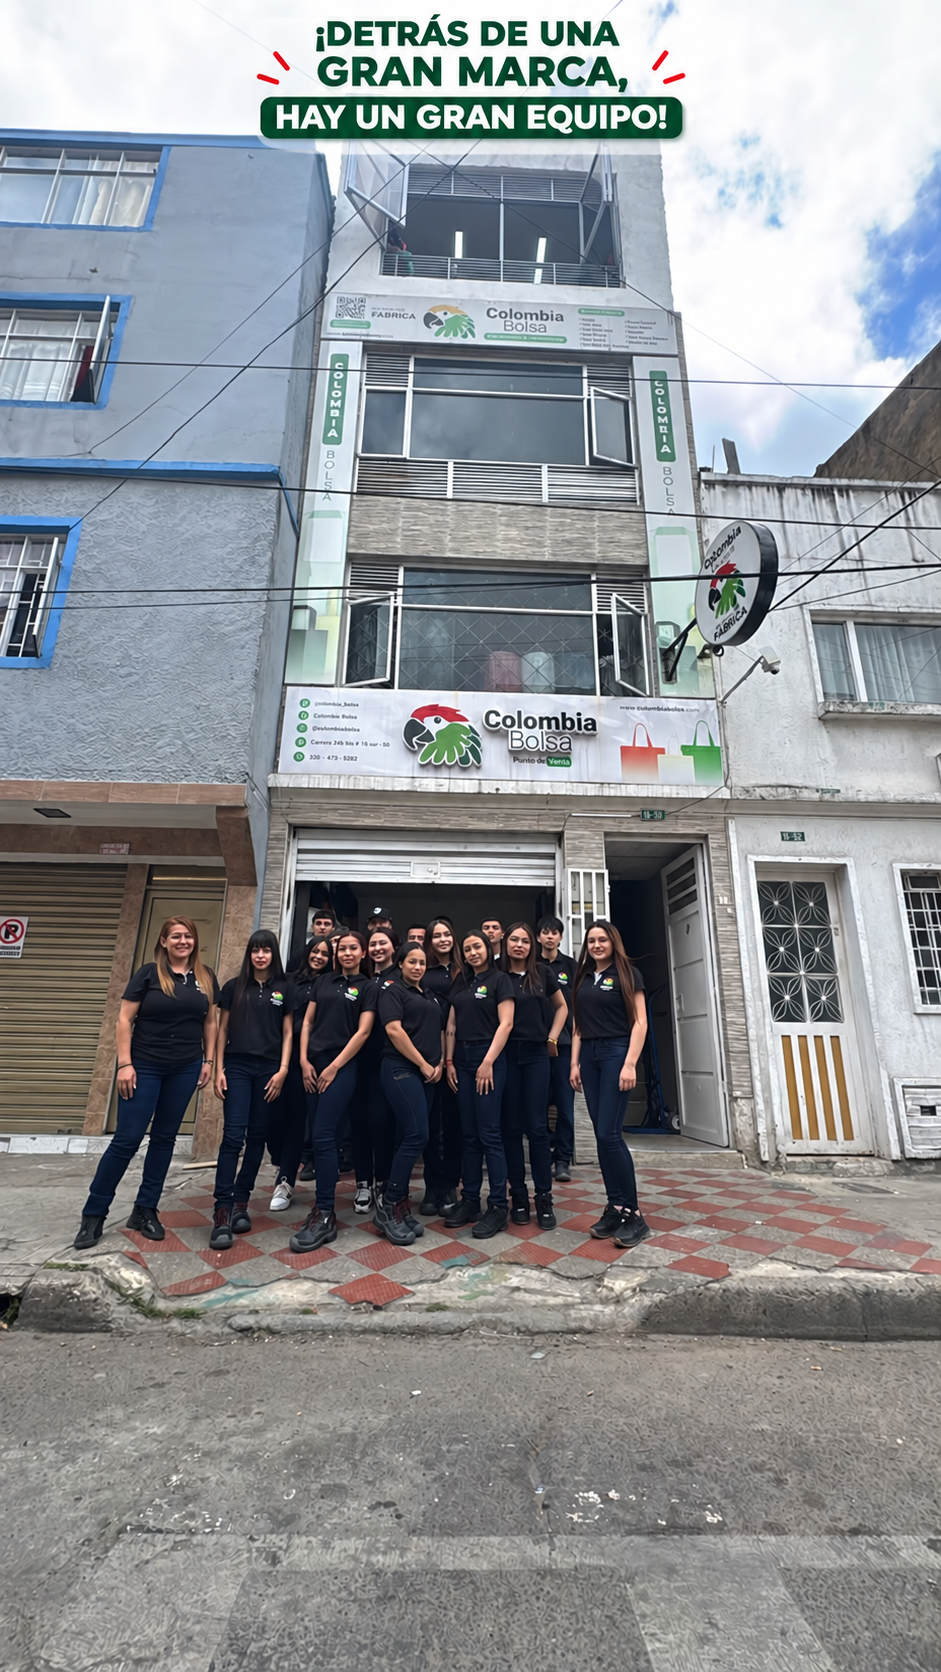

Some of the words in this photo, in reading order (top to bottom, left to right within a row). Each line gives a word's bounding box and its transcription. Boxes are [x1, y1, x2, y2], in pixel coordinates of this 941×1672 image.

[486, 307, 564, 322] Colombia
[503, 320, 547, 333] Bolsa
[327, 362, 344, 438] COLOMBIA
[654, 379, 672, 453] COLOMBIA
[322, 450, 335, 501] BOLSA
[662, 466, 675, 516] BOLSA
[484, 709, 597, 732] Colombia
[509, 731, 572, 752] Bolsa
[513, 756, 536, 765] Punto
[536, 757, 546, 765] de
[548, 757, 571, 767] Venta
